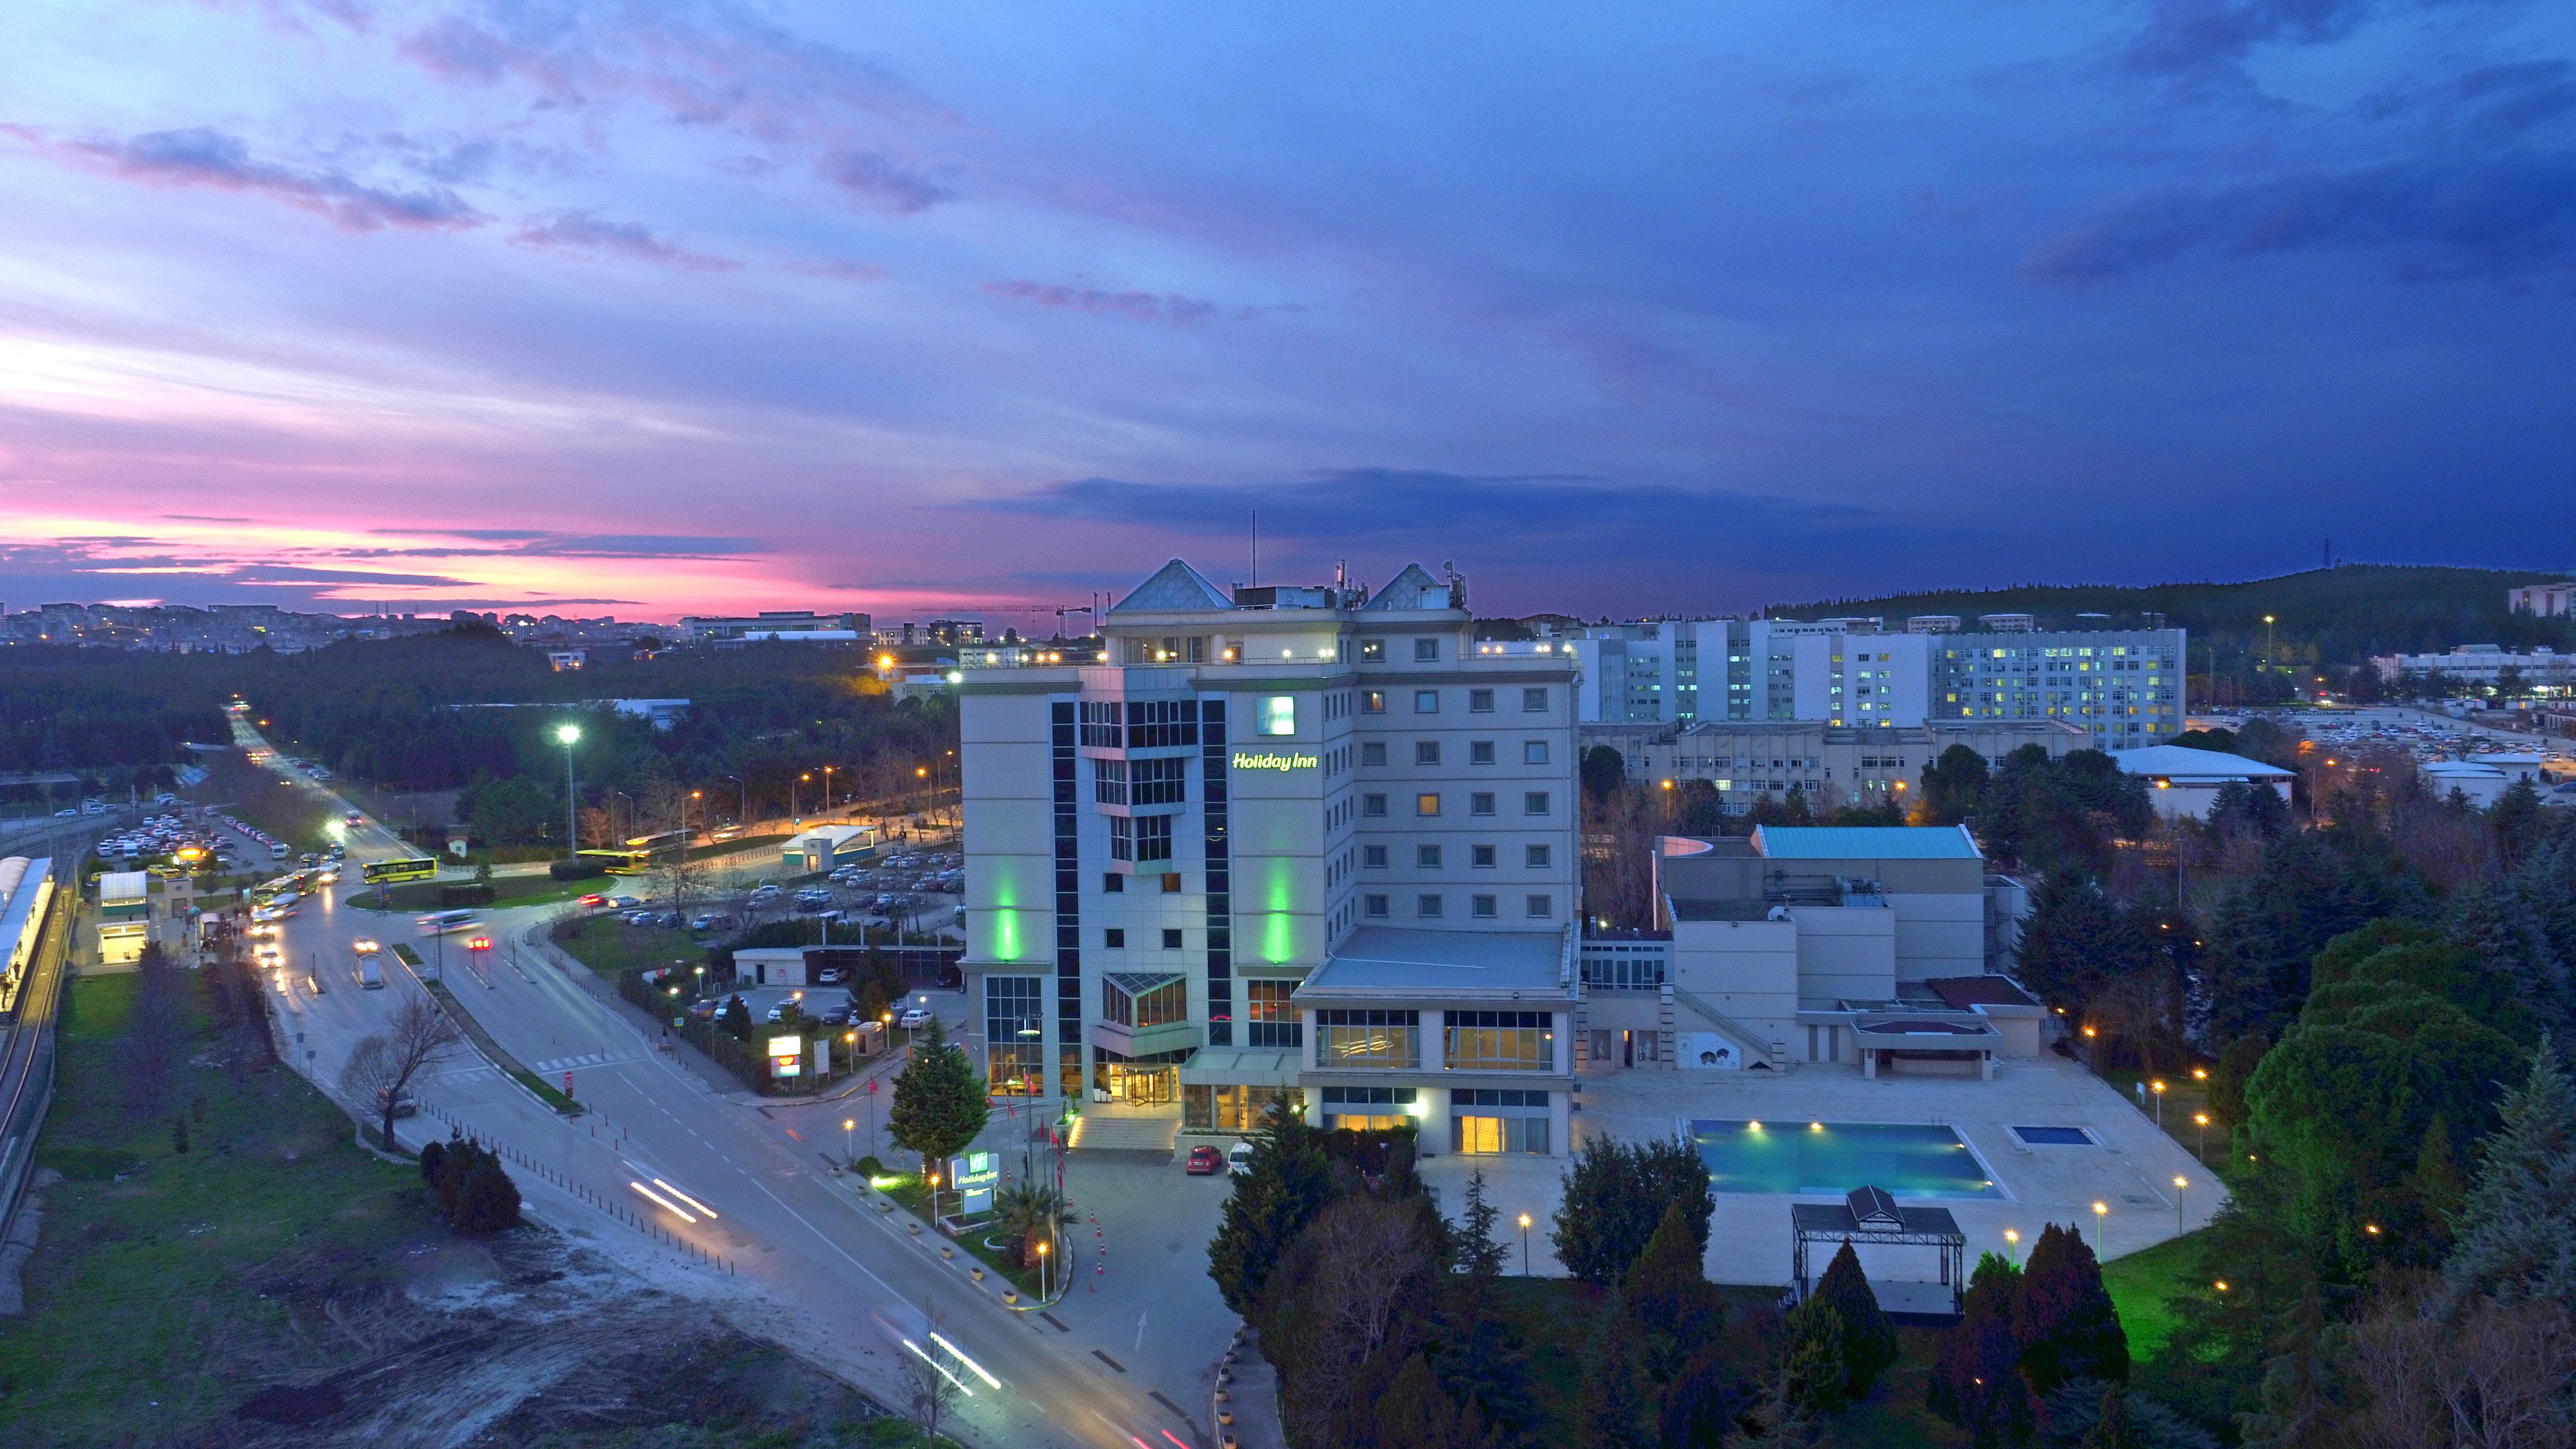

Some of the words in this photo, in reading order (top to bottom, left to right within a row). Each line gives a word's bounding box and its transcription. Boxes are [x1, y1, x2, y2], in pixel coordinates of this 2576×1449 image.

[1233, 752, 1291, 771] Holiday
[1292, 752, 1317, 768] Inn
[958, 1174, 986, 1184] Holiday
[986, 1171, 997, 1180] Inn
